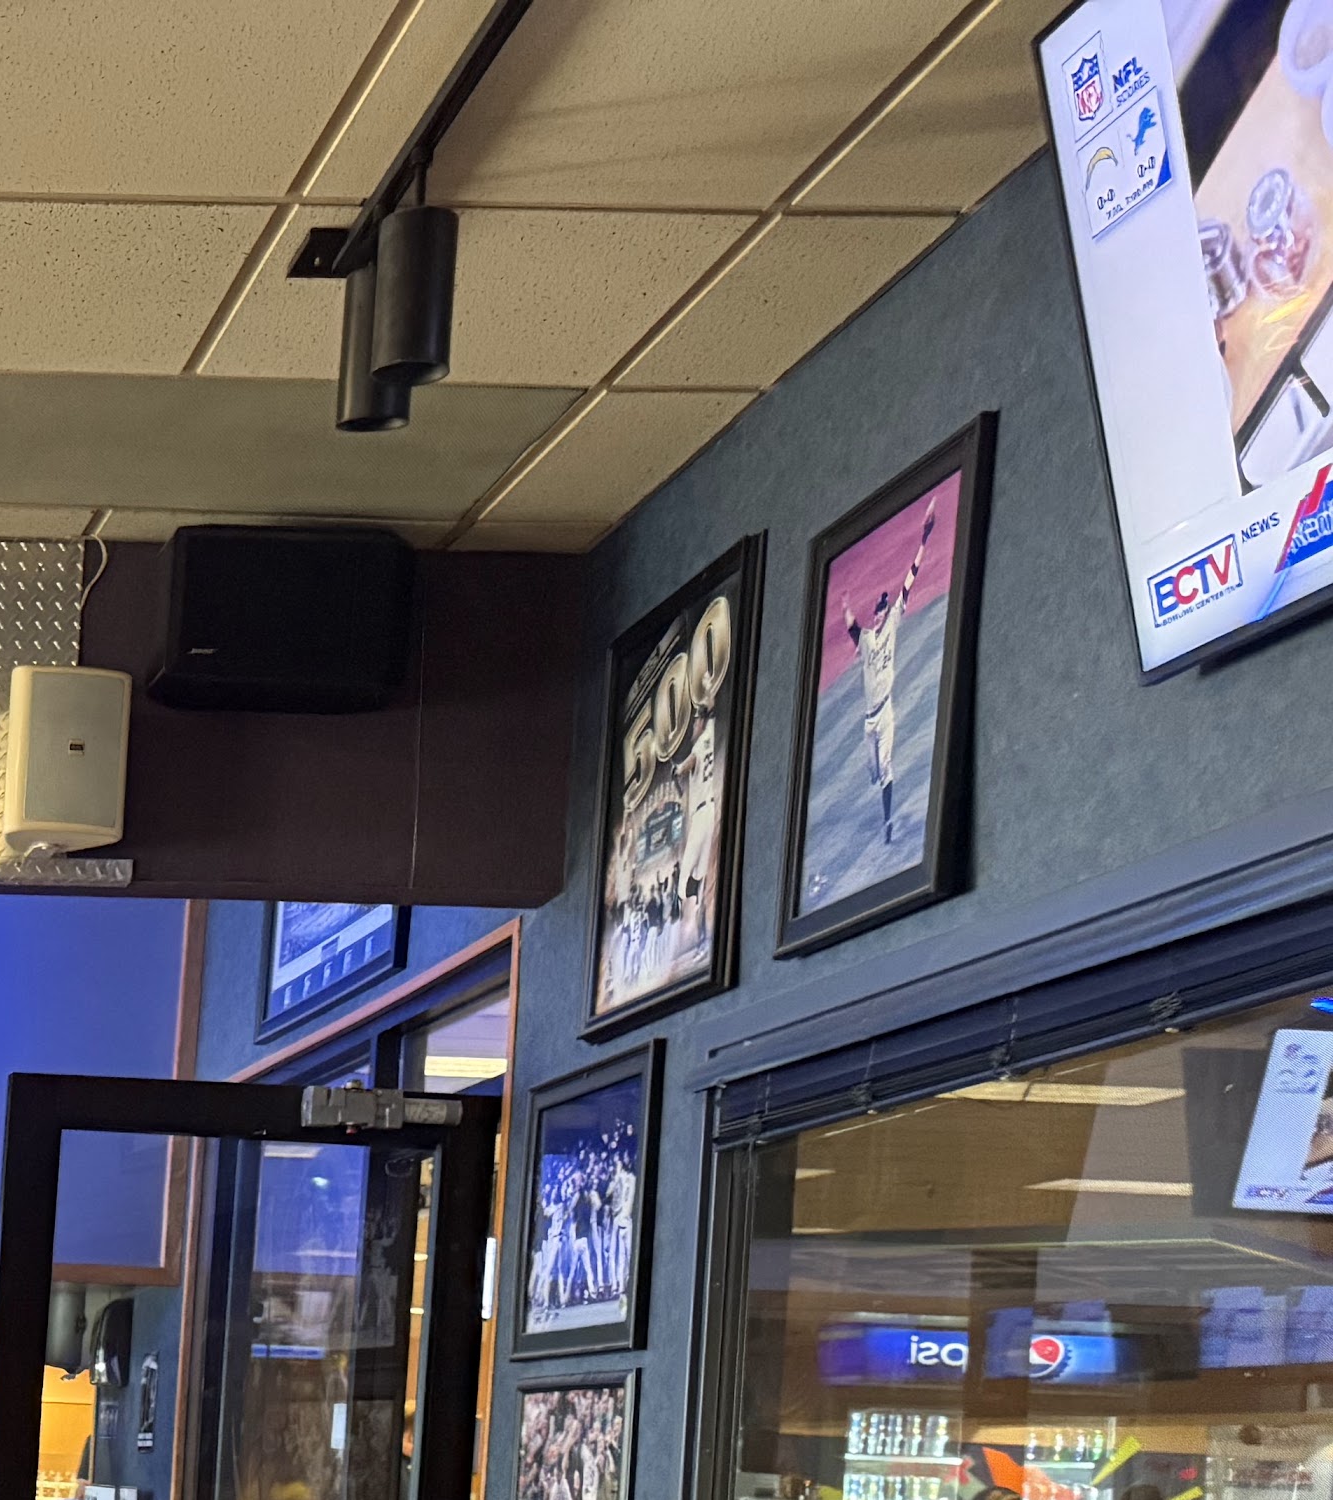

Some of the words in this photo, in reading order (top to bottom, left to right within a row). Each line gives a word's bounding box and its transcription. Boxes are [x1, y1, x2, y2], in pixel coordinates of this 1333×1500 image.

[1112, 57, 1143, 92] NFL
[1241, 512, 1281, 544] NEWS
[1154, 543, 1232, 617] BCTV
[623, 596, 731, 812] 500
